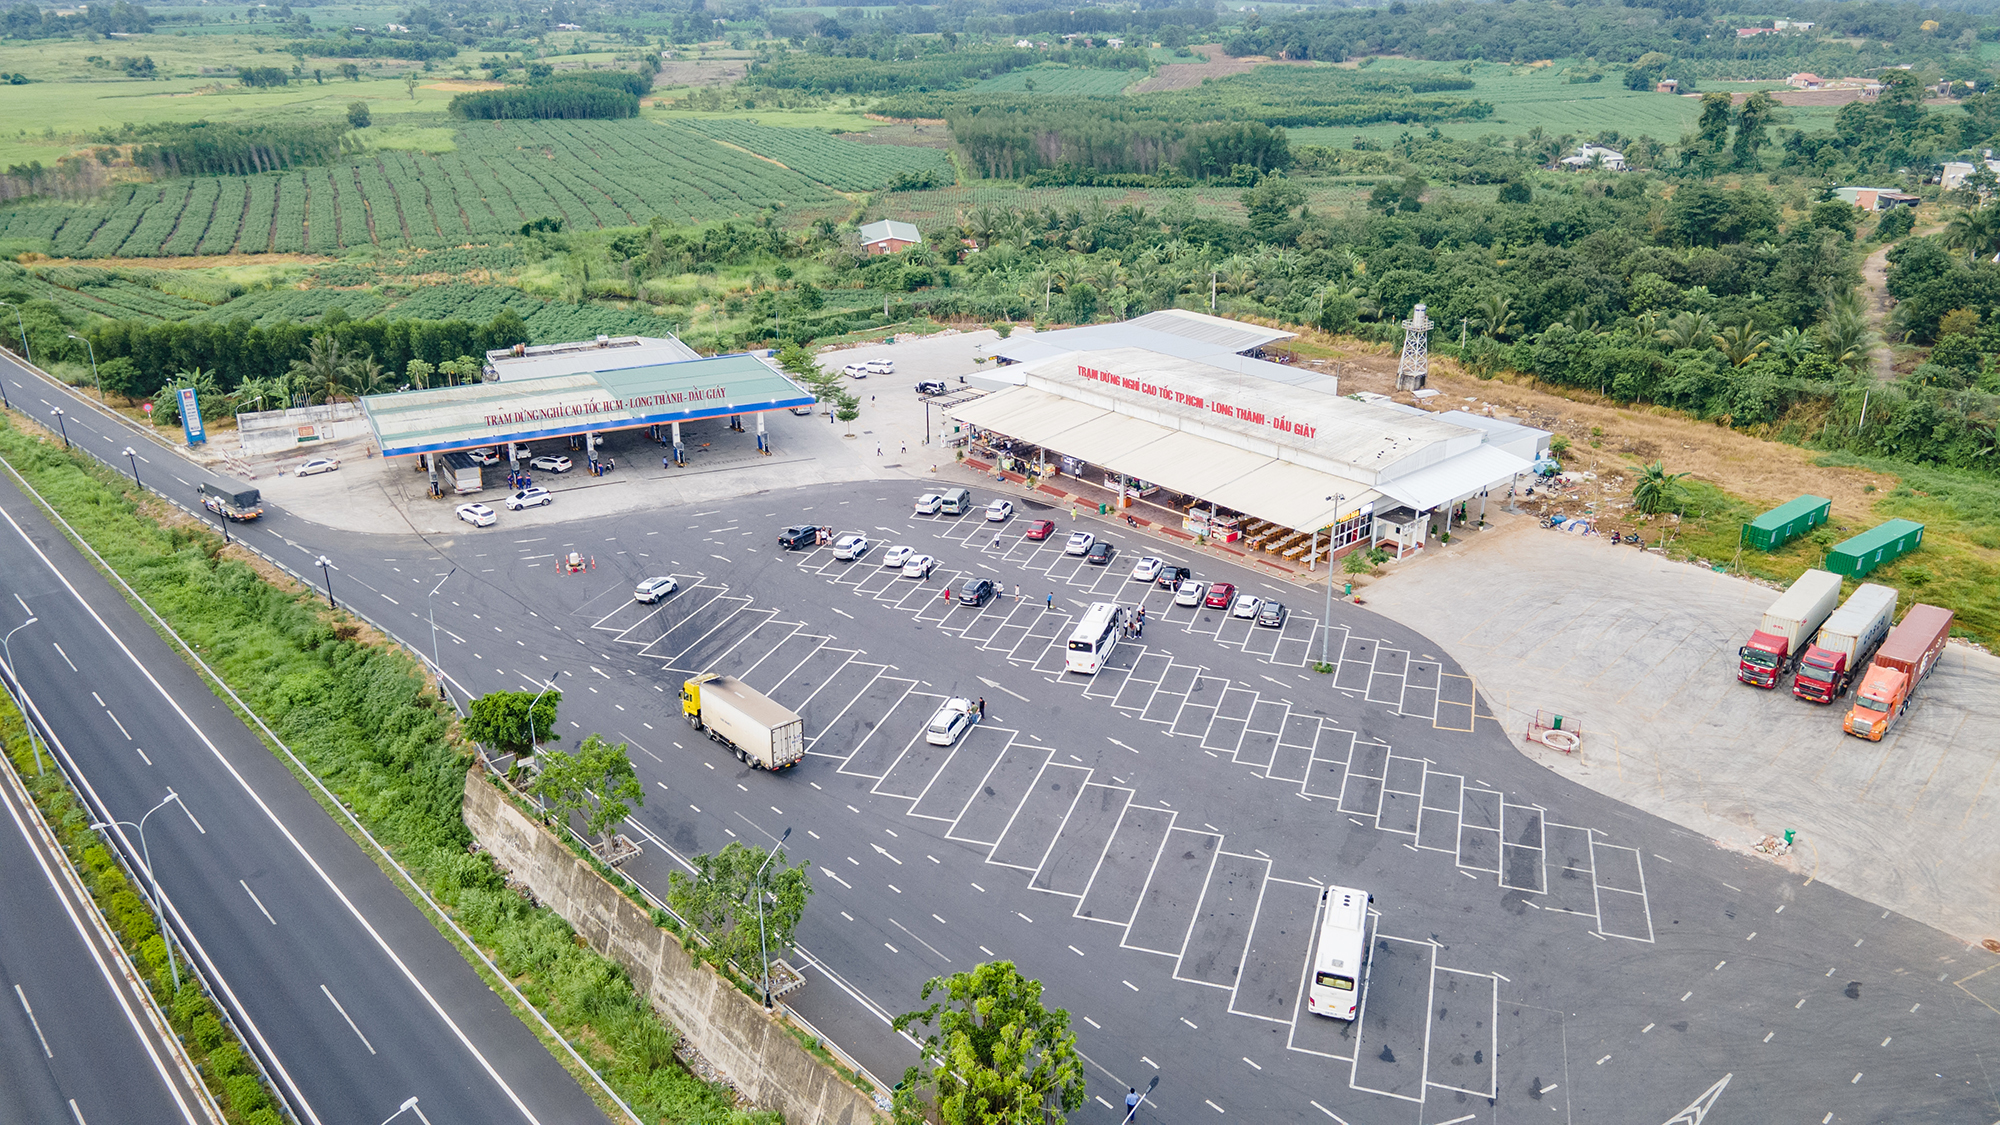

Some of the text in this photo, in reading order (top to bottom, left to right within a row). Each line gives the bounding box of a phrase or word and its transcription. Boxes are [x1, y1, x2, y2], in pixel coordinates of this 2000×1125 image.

[564, 404, 583, 417] CAO
[584, 397, 601, 414] TỐC
[603, 399, 623, 412] HCM
[629, 395, 653, 408] LONG
[653, 390, 683, 405] THÀNH
[1077, 365, 1098, 381] TRẠM
[1100, 370, 1120, 386] DỪNG
[1142, 382, 1157, 396] CAO
[1159, 384, 1173, 400] TỐC
[1175, 391, 1204, 410] TP.HCM
[1211, 401, 1233, 417] LONG
